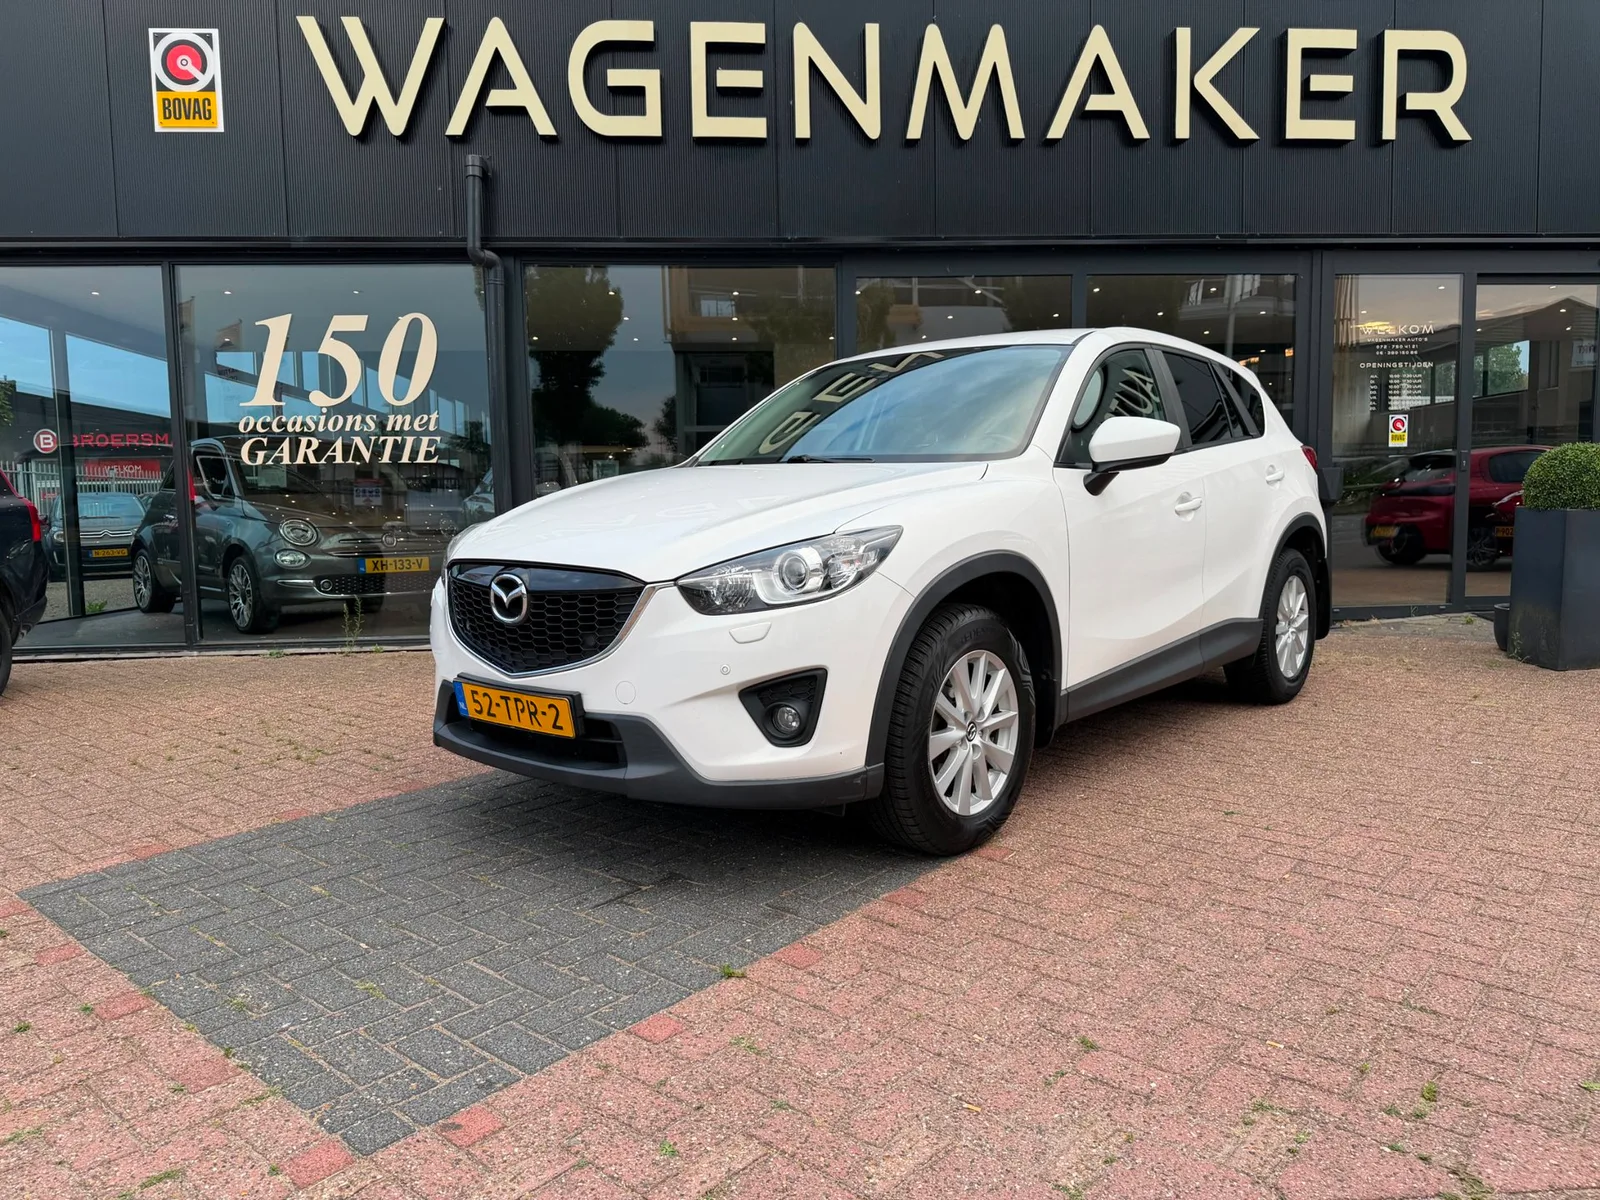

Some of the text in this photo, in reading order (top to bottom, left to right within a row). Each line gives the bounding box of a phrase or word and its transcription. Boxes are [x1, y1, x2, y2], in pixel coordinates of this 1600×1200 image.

[296, 15, 1473, 143] WAGENMAKER
[162, 97, 212, 120] BOVAG
[239, 312, 438, 407] 150
[238, 407, 440, 433] occasions met
[240, 436, 441, 466] GARANTIE
[372, 558, 423, 572] XH-133-V
[471, 690, 564, 731] 52-TPR-2
